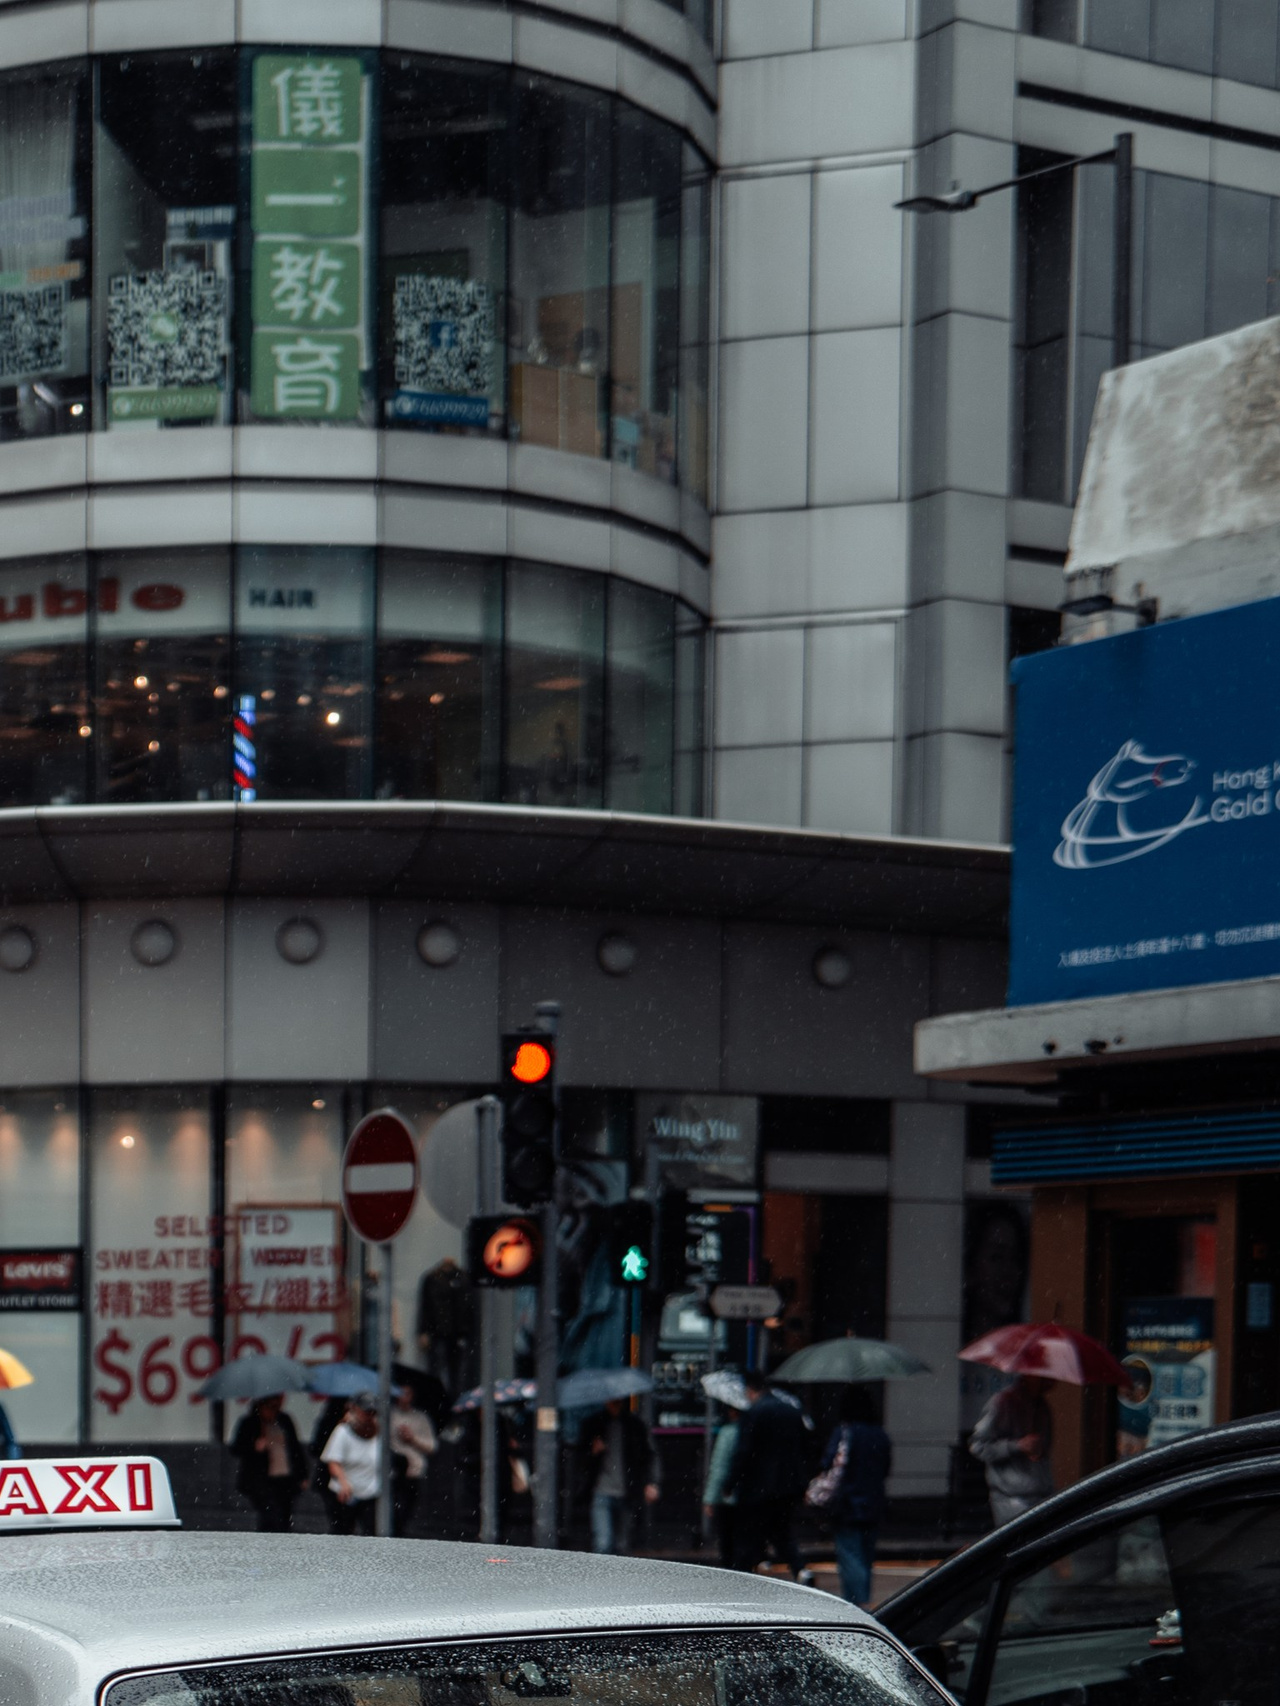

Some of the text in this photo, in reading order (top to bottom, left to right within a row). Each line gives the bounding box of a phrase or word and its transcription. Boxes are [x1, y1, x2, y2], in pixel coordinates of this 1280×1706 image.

[266, 64, 346, 415] 儀一教育
[249, 588, 316, 608] HAIR
[1212, 764, 1271, 792] Hong
[1210, 789, 1271, 823] Gold
[154, 1215, 291, 1238] SELECTED
